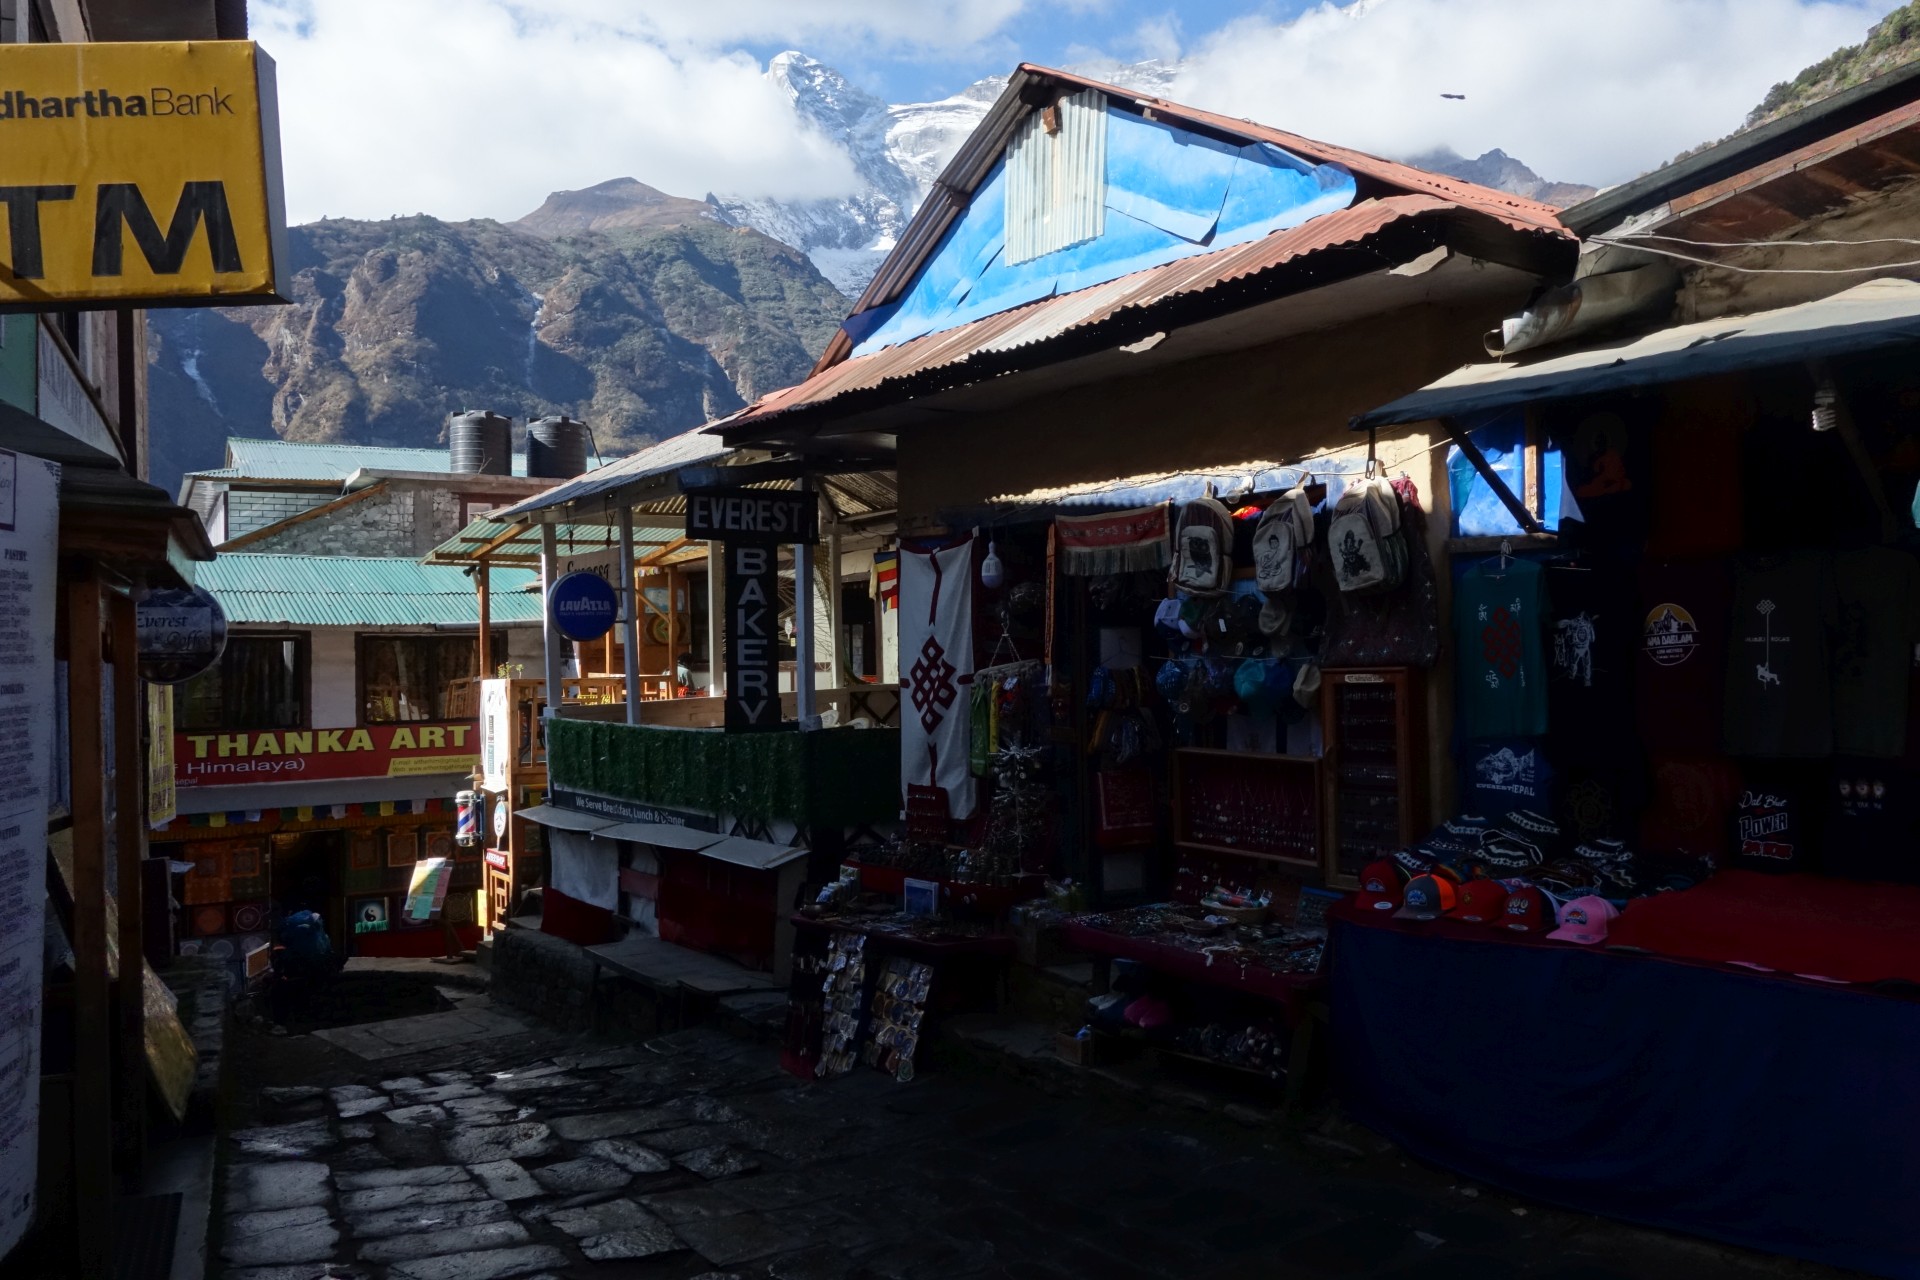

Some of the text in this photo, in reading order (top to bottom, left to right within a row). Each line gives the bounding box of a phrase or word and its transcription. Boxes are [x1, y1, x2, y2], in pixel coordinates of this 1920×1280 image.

[693, 495, 803, 533] EVEREST
[559, 596, 611, 612] LAVAZZA
[137, 611, 188, 628] Everest
[736, 547, 769, 724] BAKERY
[187, 728, 376, 759] THANKA
[389, 725, 472, 750] ART
[187, 758, 306, 775] Himalaya)
[575, 796, 585, 807] We
[585, 798, 602, 811] Serve
[633, 807, 653, 821] Lunch
[654, 810, 660, 822] &
[1739, 812, 1788, 840] POWER
